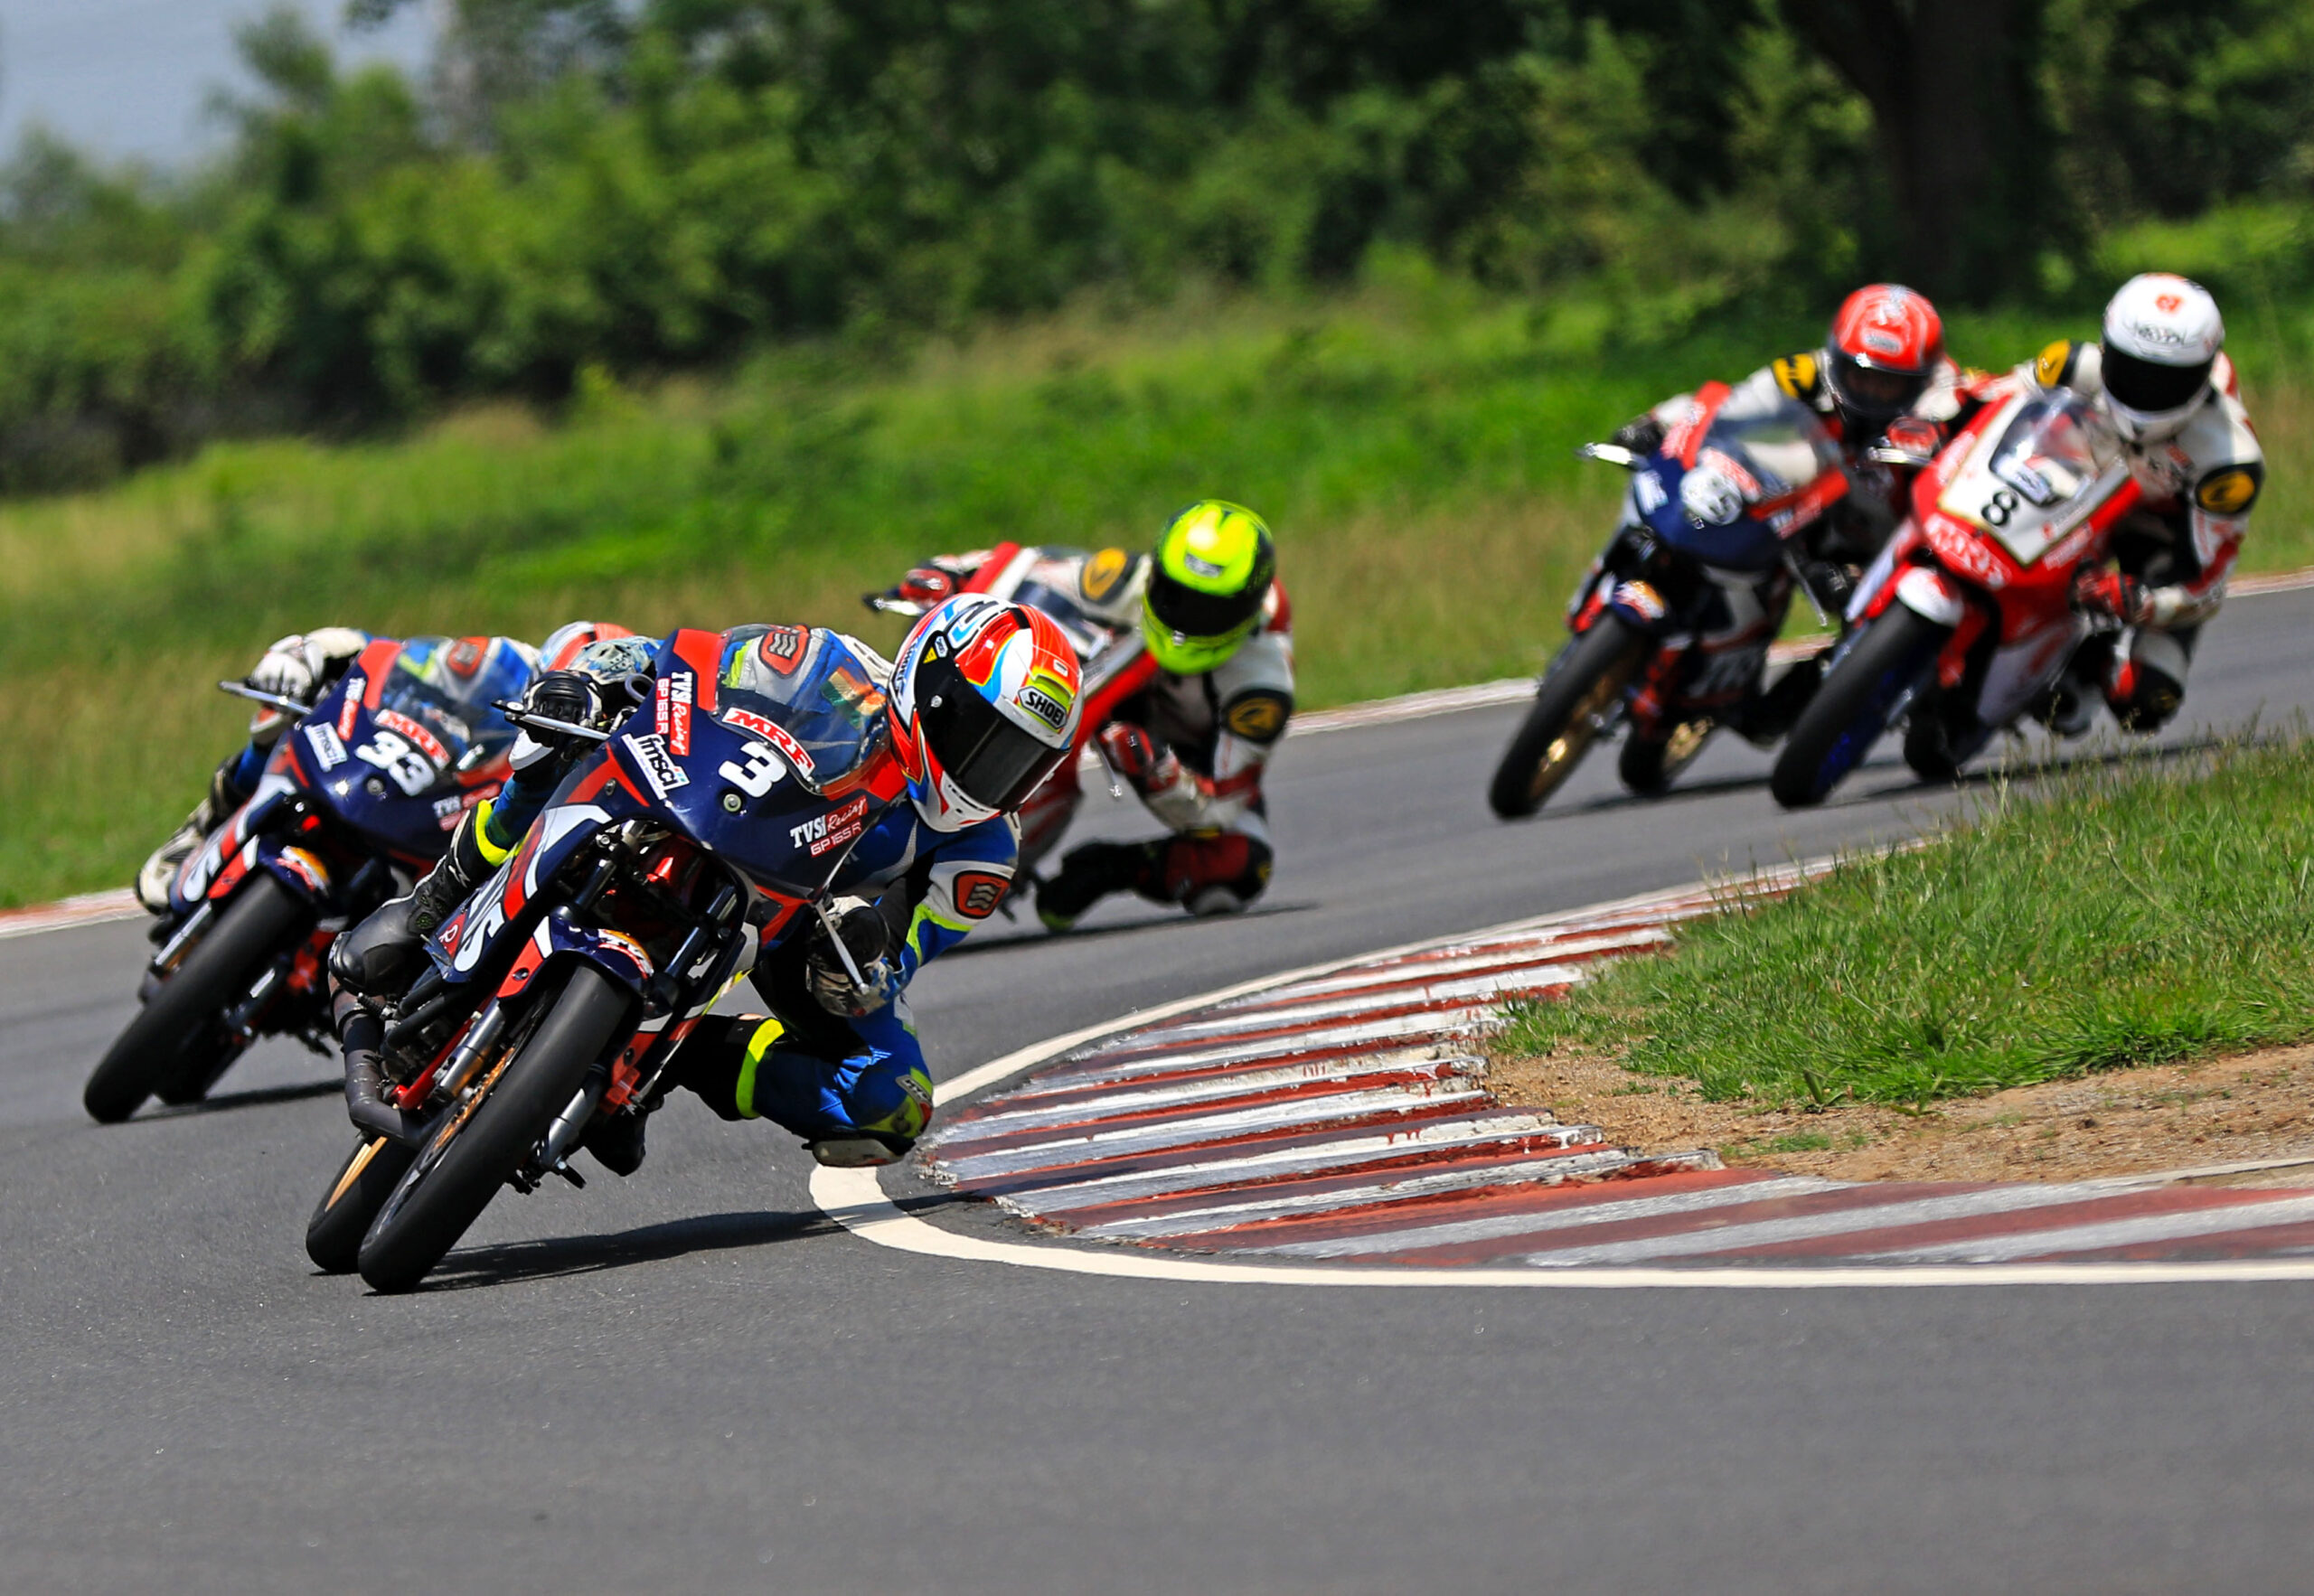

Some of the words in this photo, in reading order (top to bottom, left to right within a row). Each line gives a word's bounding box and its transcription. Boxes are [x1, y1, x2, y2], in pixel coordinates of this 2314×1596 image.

[1980, 491, 2018, 527] 8
[671, 671, 692, 704] TVS
[1025, 690, 1066, 726] SHOEI
[354, 730, 435, 796] 33
[379, 710, 450, 767] MRF
[638, 737, 679, 787] fmsci
[726, 710, 813, 769] MRF
[719, 741, 787, 797] 3
[789, 814, 827, 849] TVS
